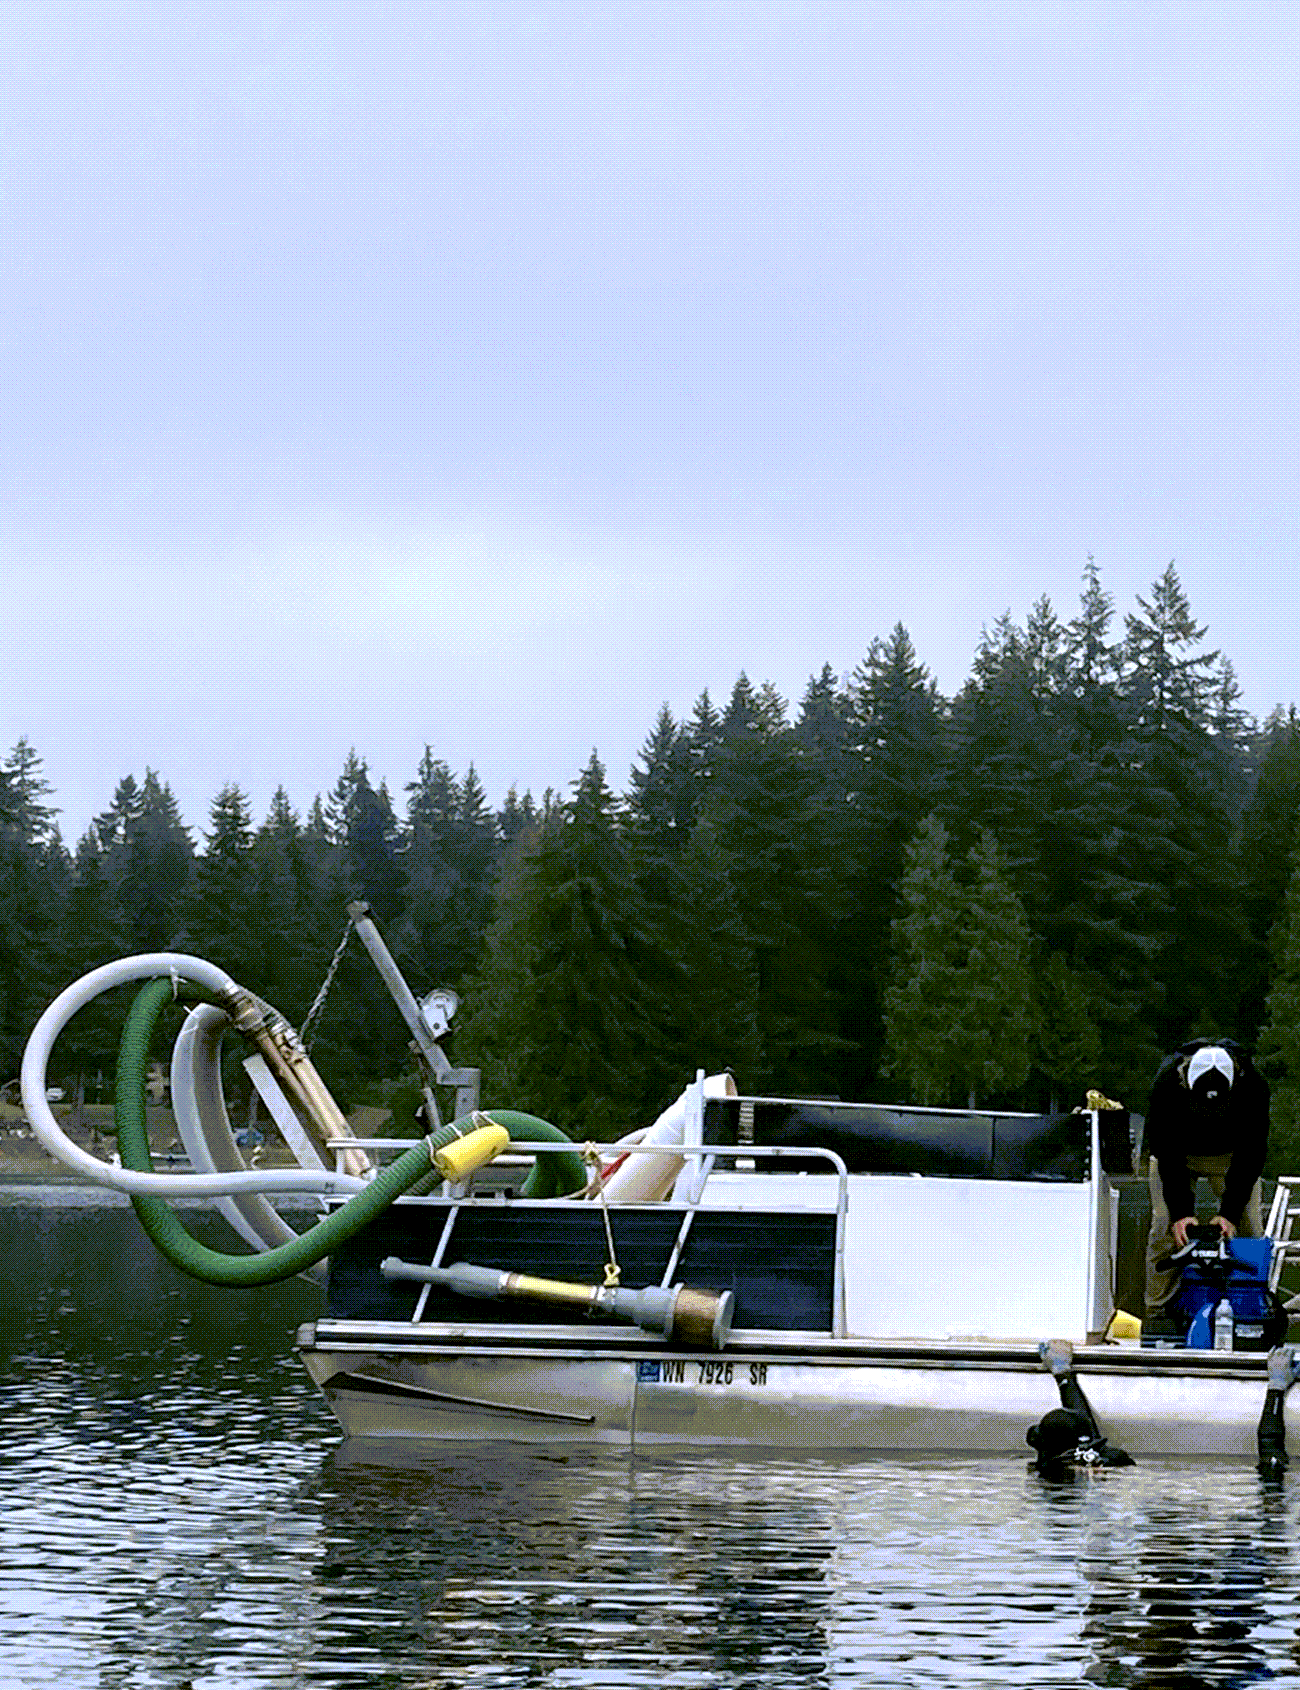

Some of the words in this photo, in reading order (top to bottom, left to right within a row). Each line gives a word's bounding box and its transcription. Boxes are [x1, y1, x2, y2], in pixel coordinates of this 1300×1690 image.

[661, 1360, 686, 1383] WN
[698, 1362, 733, 1385] 7926
[749, 1363, 767, 1386] SR
